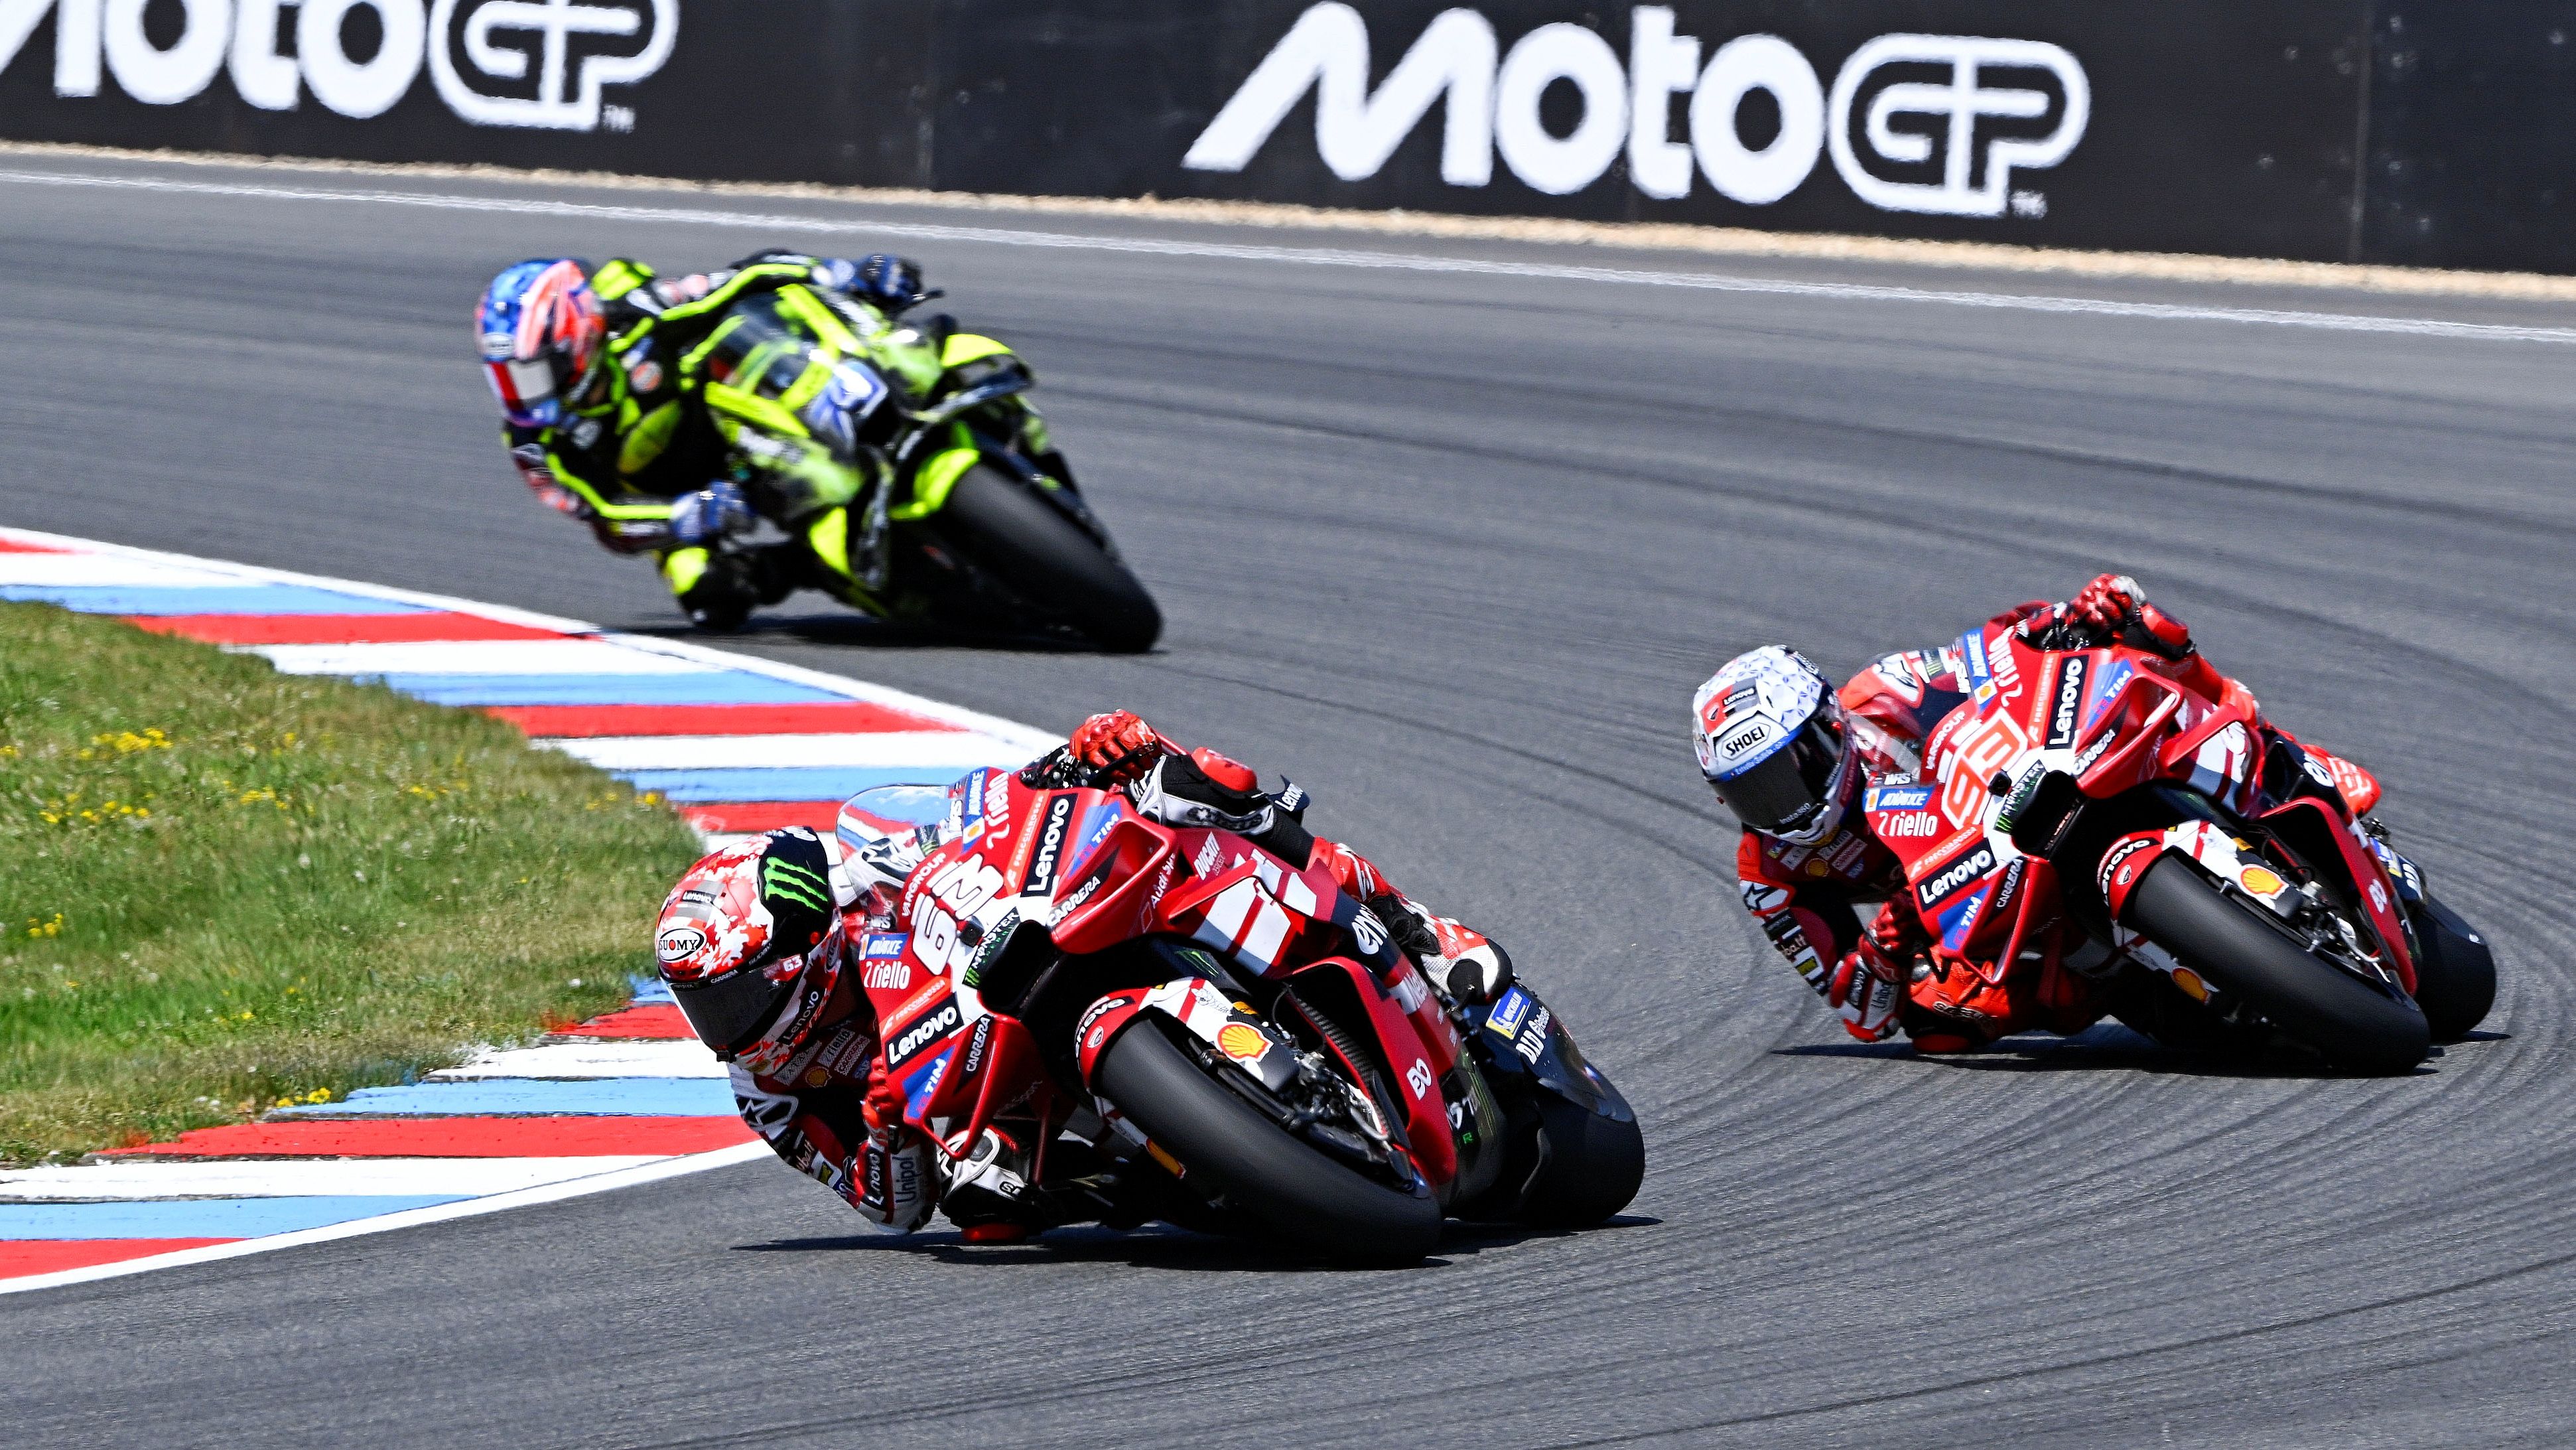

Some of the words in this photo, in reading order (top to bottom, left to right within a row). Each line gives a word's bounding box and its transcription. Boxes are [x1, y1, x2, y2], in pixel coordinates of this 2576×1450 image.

[1181, 3, 2090, 217] MotoGP
[2049, 659, 2082, 745] Lenovo
[2105, 670, 2132, 698] TIM
[1726, 726, 1765, 756] SHOEI
[2073, 729, 2116, 775] CARRERA
[1941, 707, 2028, 830] 93
[1027, 798, 1069, 891] Lenovo
[1091, 814, 1120, 843] TIM
[1889, 811, 1938, 837] riello
[1194, 831, 1221, 881] DUCATI
[1920, 849, 1991, 904] Lenovo
[902, 852, 947, 917] VARGROUP
[1046, 876, 1101, 926] CARRERA
[1151, 871, 1170, 909] Audi
[910, 853, 1004, 976] 63
[1960, 896, 1983, 926] TIM
[659, 939, 698, 951] SUOMY
[783, 955, 803, 972] 63
[711, 969, 738, 983] CARRERA
[870, 960, 911, 989] riello
[783, 991, 819, 1041] Lenovo
[1503, 991, 1523, 1021] MICHELIN
[889, 1007, 957, 1064] Lenovo
[966, 1017, 990, 1072] CARRERA
[925, 1058, 946, 1093] TIM
[867, 1153, 884, 1205] Lnovo
[892, 1156, 922, 1204] Unipol
